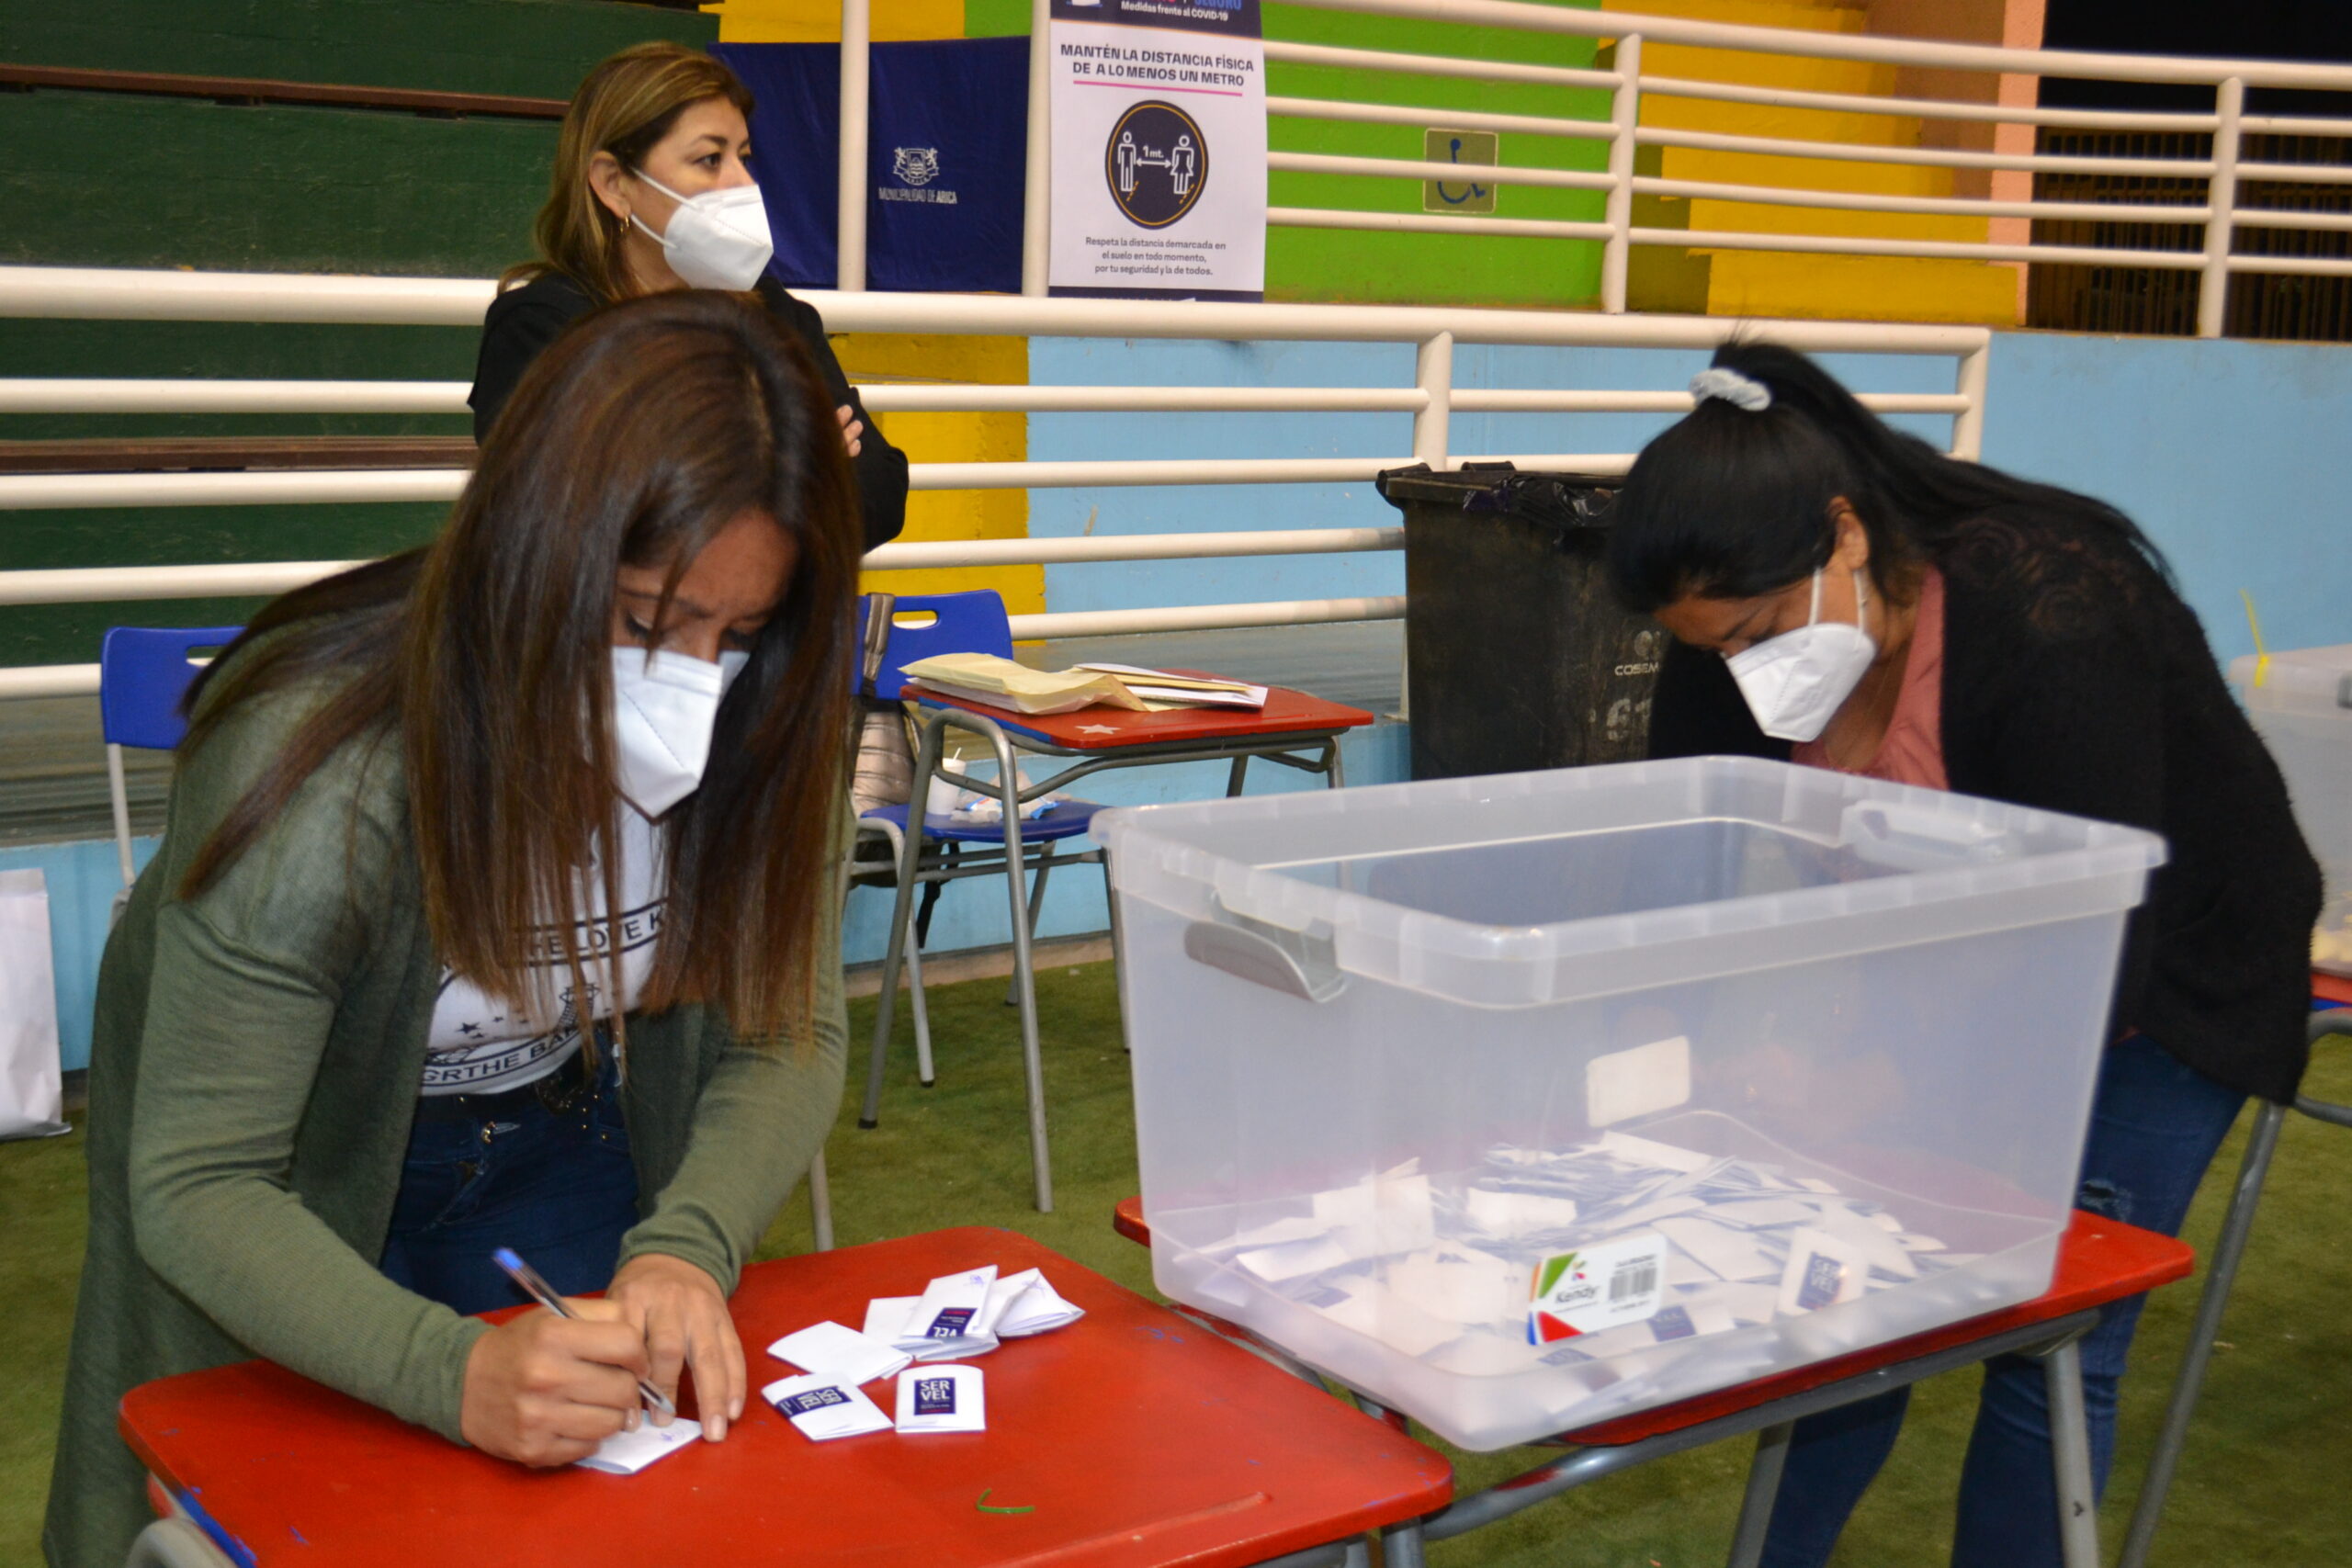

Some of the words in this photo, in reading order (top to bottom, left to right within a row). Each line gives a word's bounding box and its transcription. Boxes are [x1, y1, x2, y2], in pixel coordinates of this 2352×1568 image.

[1121, 2, 1157, 14] Medidas
[1157, 4, 1182, 16] frente
[1182, 7, 1191, 17] al
[1191, 8, 1228, 21] COVID-19
[1060, 44, 1120, 60] MANTÉN
[1123, 49, 1137, 62] LA
[1142, 51, 1213, 68] DISTANCIA
[1216, 54, 1254, 72] FÍSICA
[1073, 62, 1091, 74] DE
[1096, 63, 1105, 75] A
[1108, 64, 1124, 76] LO
[1126, 66, 1176, 81] MENOS
[1180, 69, 1198, 83] UN
[1201, 71, 1244, 86] METRO
[1143, 146, 1148, 157] 1
[1086, 237, 1119, 248] Respeta
[1121, 237, 1128, 246] la
[1129, 237, 1164, 248] distancia
[1165, 239, 1214, 250] demarcada
[1215, 242, 1226, 250] en
[1102, 251, 1110, 259] el
[1111, 251, 1132, 260] suelo
[1145, 252, 1162, 261] todo
[1164, 253, 1207, 264] momento,
[1094, 265, 1108, 274] por
[1110, 264, 1119, 273] tu
[1120, 264, 1159, 276] seguridad
[1159, 266, 1165, 276] y
[1165, 265, 1172, 275] la
[1173, 265, 1184, 276] de
[1185, 266, 1213, 276] todos.
[920, 1380, 950, 1391] SER
[921, 1389, 950, 1401] VEL
